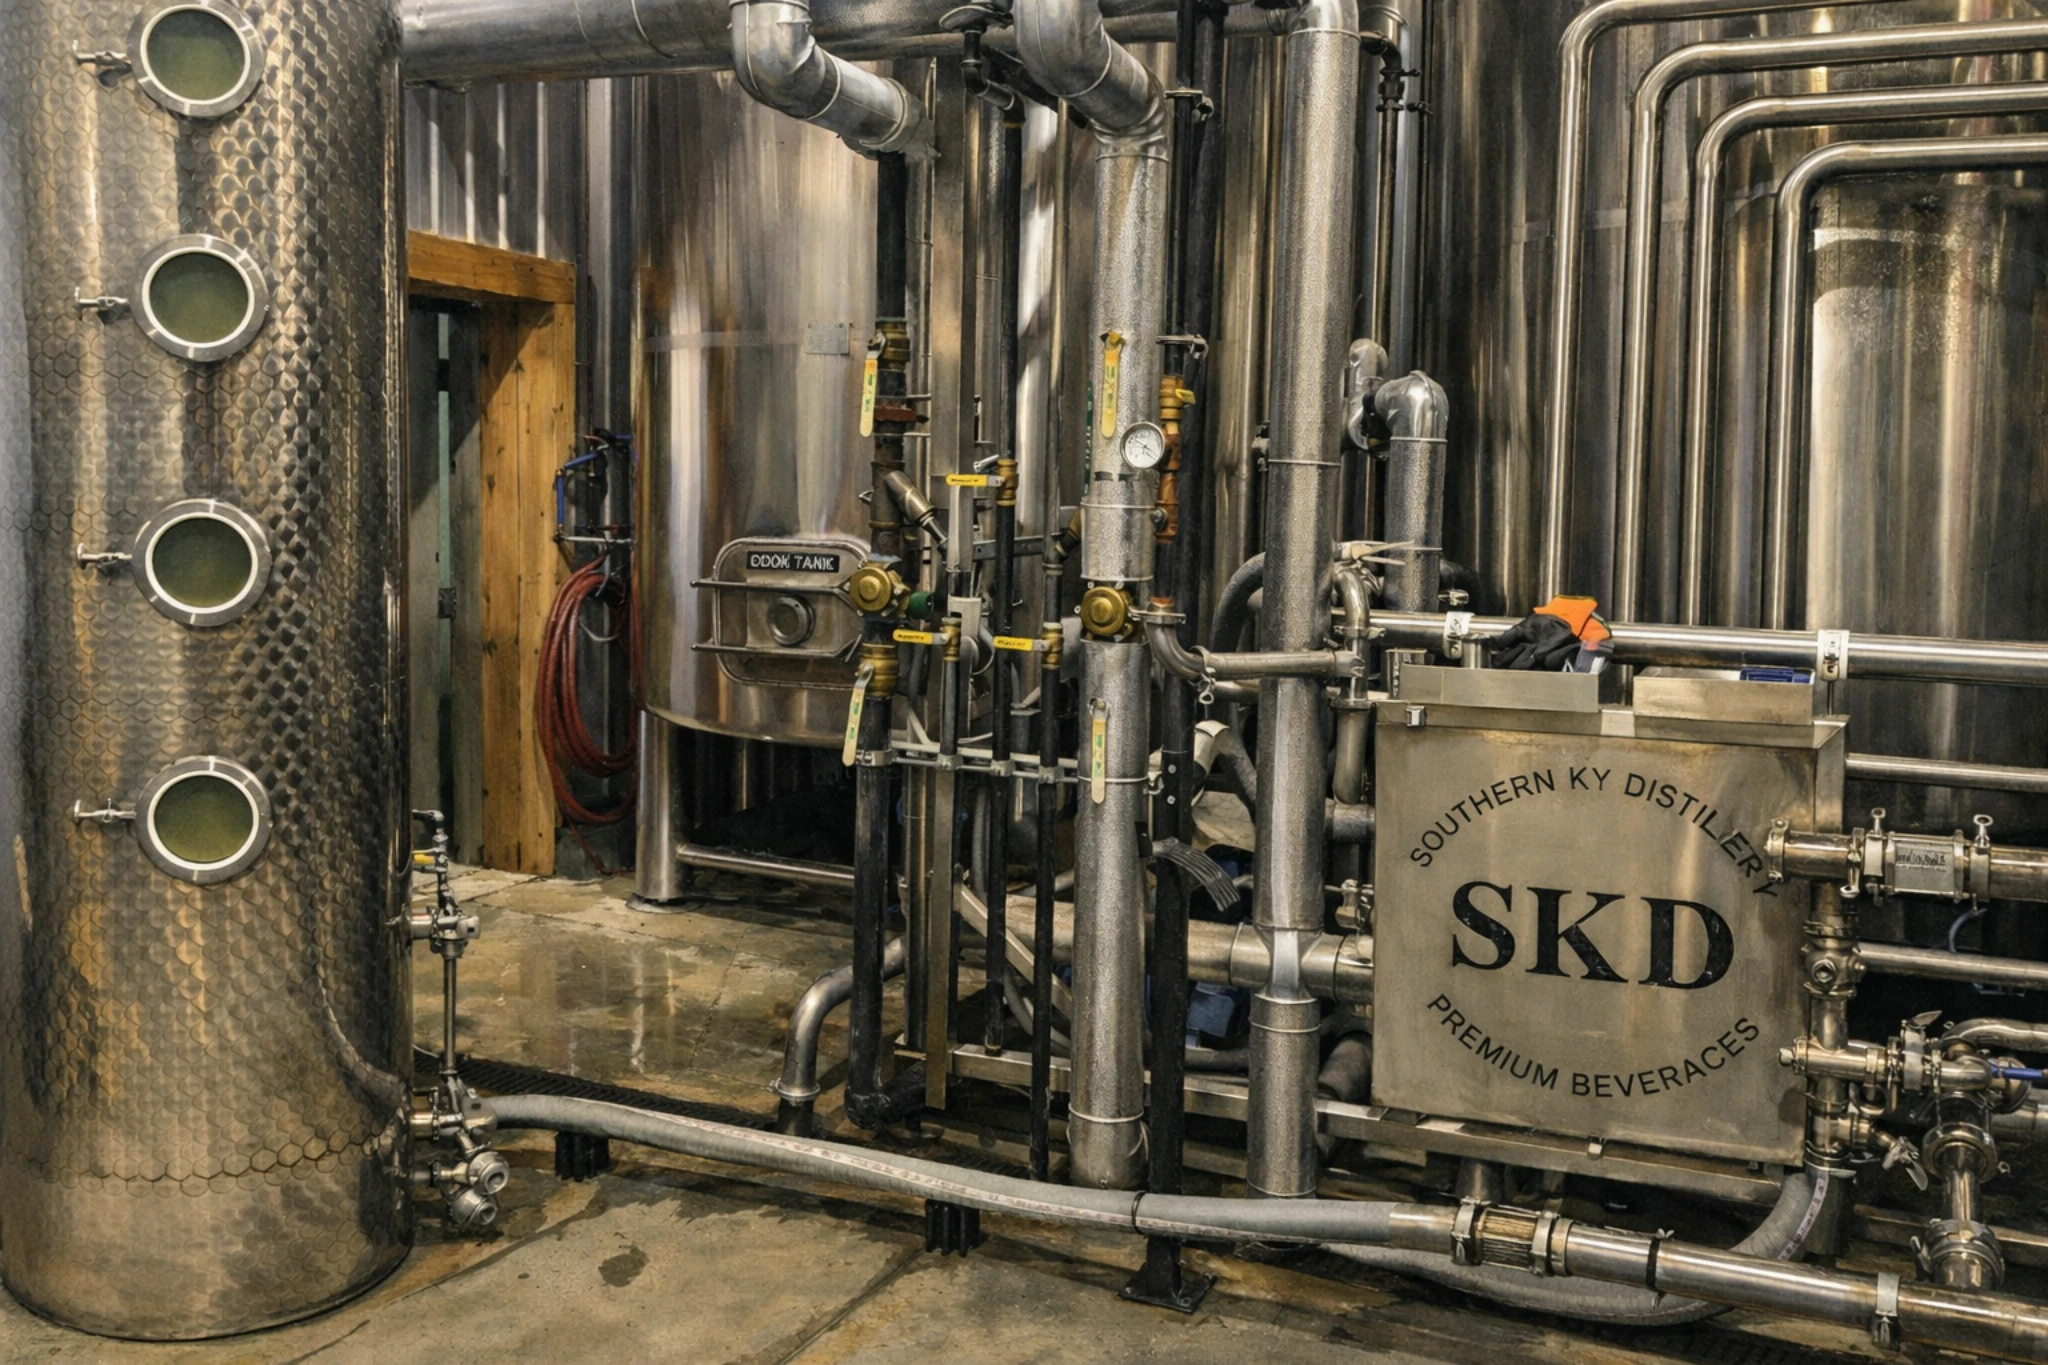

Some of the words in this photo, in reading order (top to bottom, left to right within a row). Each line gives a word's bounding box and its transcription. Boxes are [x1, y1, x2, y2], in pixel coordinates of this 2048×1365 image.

[794, 554, 835, 571] TANK
[1410, 769, 1555, 867] SOUTHERN
[1569, 766, 1611, 791] KY
[1452, 880, 1735, 990] SKD
[1427, 993, 1558, 1090] PREMIUM
